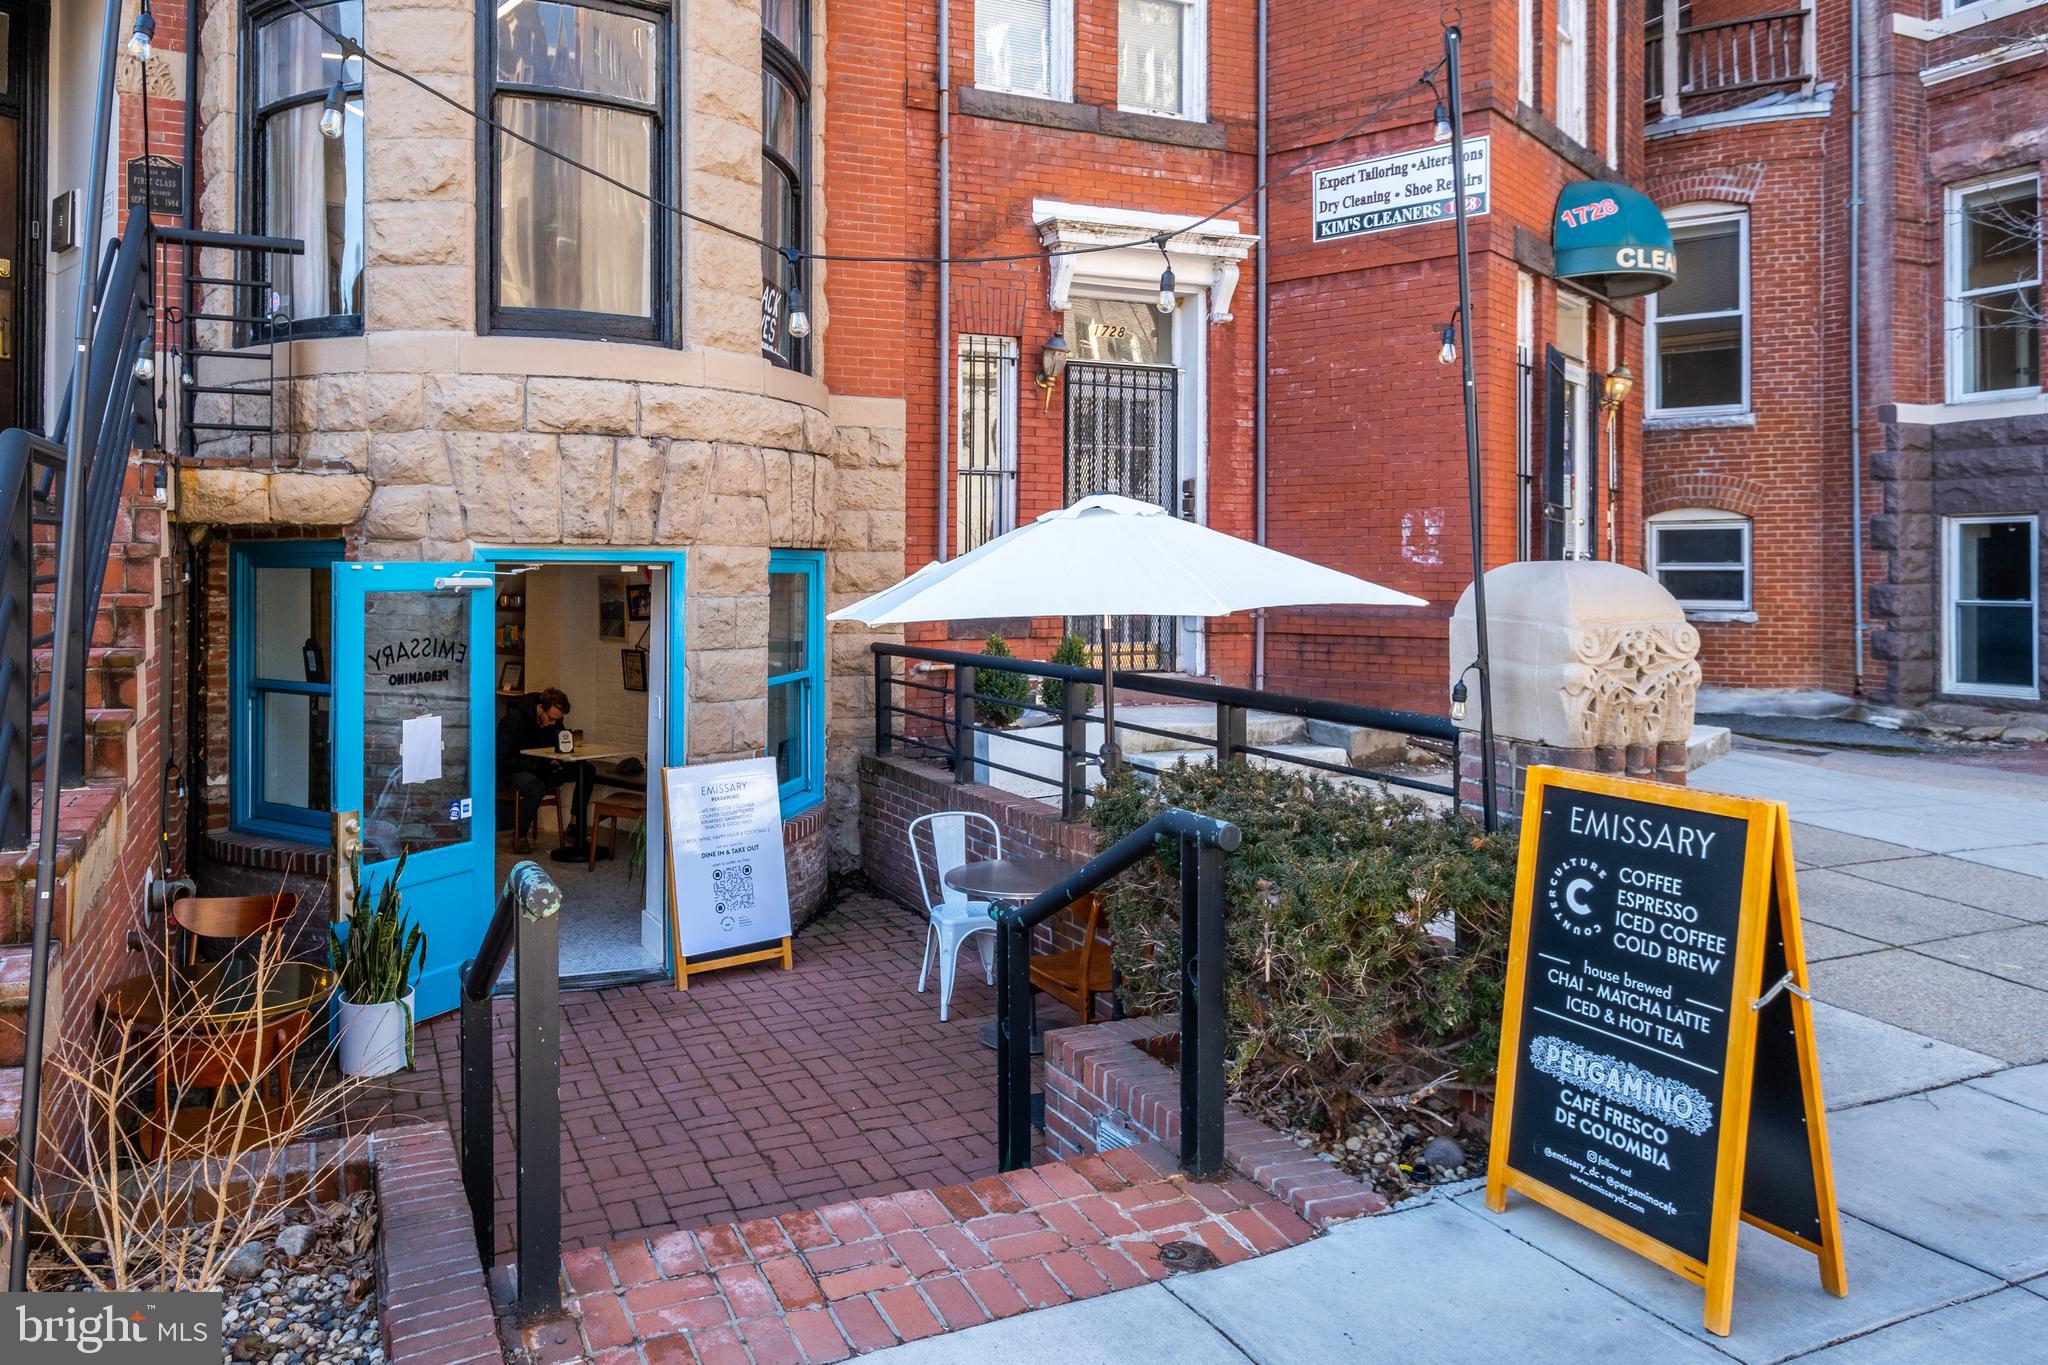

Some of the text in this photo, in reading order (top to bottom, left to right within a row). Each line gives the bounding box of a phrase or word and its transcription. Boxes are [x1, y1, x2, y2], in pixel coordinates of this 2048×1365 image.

[133, 176, 153, 186] FIRT
[1318, 149, 1483, 191] Expert Tailoring Alteraons
[1319, 173, 1482, 214] Dry Cleaning Shoe Reirs
[1561, 198, 1619, 228] 1728
[1321, 217, 1361, 237] KIM'S
[1363, 203, 1442, 228] CLEANERS
[1616, 248, 1677, 273] CLEA
[1094, 325, 1126, 338] 1728
[701, 782, 748, 796] EMISSARY
[711, 794, 740, 802] PERGAMINO
[701, 851, 716, 860] DINE
[731, 846, 746, 854] TAKE
[747, 844, 760, 852] OUT
[1570, 806, 1716, 859] EMISSARY
[1619, 867, 1683, 896] COFFEE
[1617, 889, 1698, 923] ESPRESSO
[1615, 910, 1726, 955] ICED COFFEE
[1613, 932, 1721, 976] COLD BREW
[1583, 959, 1673, 1000] house brewed
[1548, 968, 1584, 992] CHAI
[1596, 984, 1662, 1018] MATCHA
[1666, 1005, 1711, 1034] LATTE
[1566, 995, 1685, 1049] ICED & HOT TEA
[1547, 1044, 1693, 1120] PERGAMINO
[1560, 1089, 1669, 1145] CAFÉ FRESCO
[1555, 1107, 1671, 1171] DE COLOMBIA
[1544, 1147, 1678, 1215] @emissary_dc @pergaminocafe
[1598, 1155, 1632, 1177] follow us!
[1569, 1173, 1645, 1214] www.emissarydc.com
